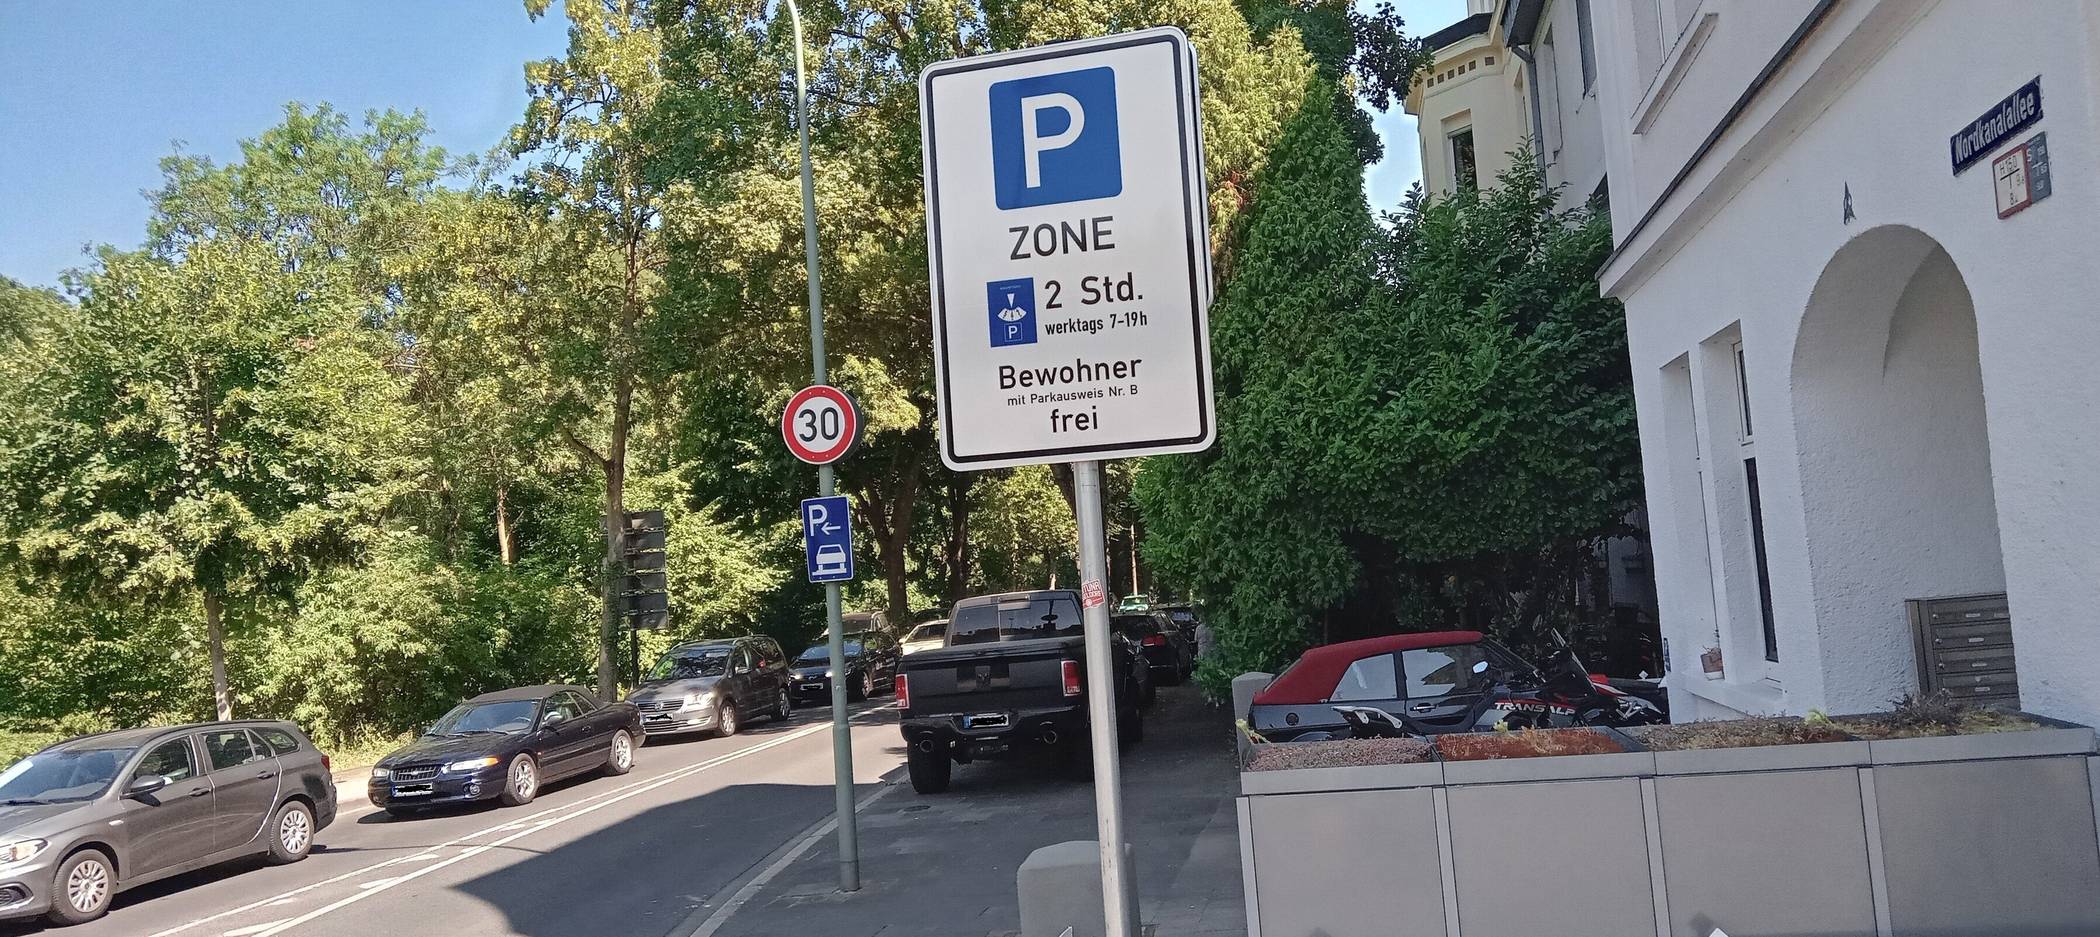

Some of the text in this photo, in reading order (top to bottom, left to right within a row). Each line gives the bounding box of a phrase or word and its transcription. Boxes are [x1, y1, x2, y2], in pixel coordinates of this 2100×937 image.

[1020, 92, 1085, 188] P
[1955, 92, 2035, 164] Nordkanalallee
[1009, 216, 1115, 260] ZONE
[1044, 272, 1143, 309] 2 Std.
[1008, 325, 1018, 339] P
[1045, 317, 1104, 336] werktags
[999, 358, 1142, 389] Bewohner
[1007, 384, 1138, 406] mit Parkausweis Nr. B
[799, 406, 839, 442] 30
[1050, 405, 1098, 433] frei
[808, 504, 828, 536] P
